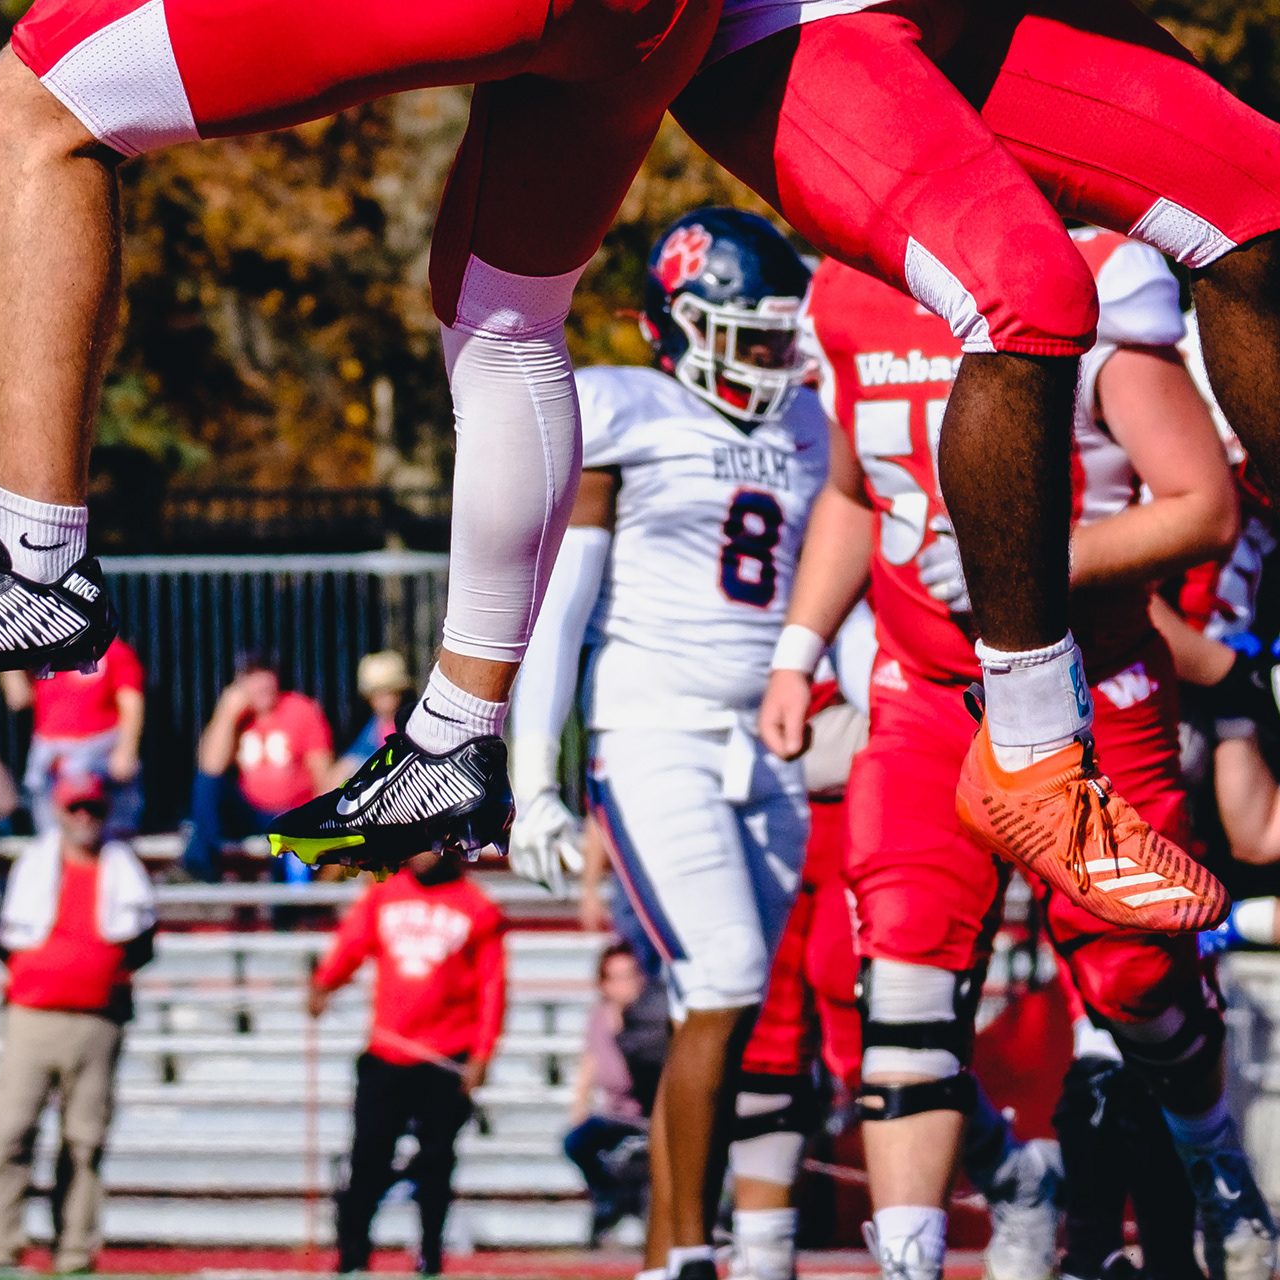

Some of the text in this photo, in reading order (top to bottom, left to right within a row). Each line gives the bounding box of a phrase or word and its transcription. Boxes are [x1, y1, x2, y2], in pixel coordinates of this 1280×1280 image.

[855, 350, 963, 386] Waba
[854, 400, 948, 566] 5
[62, 572, 101, 603] NIKE
[719, 486, 784, 610] 8
